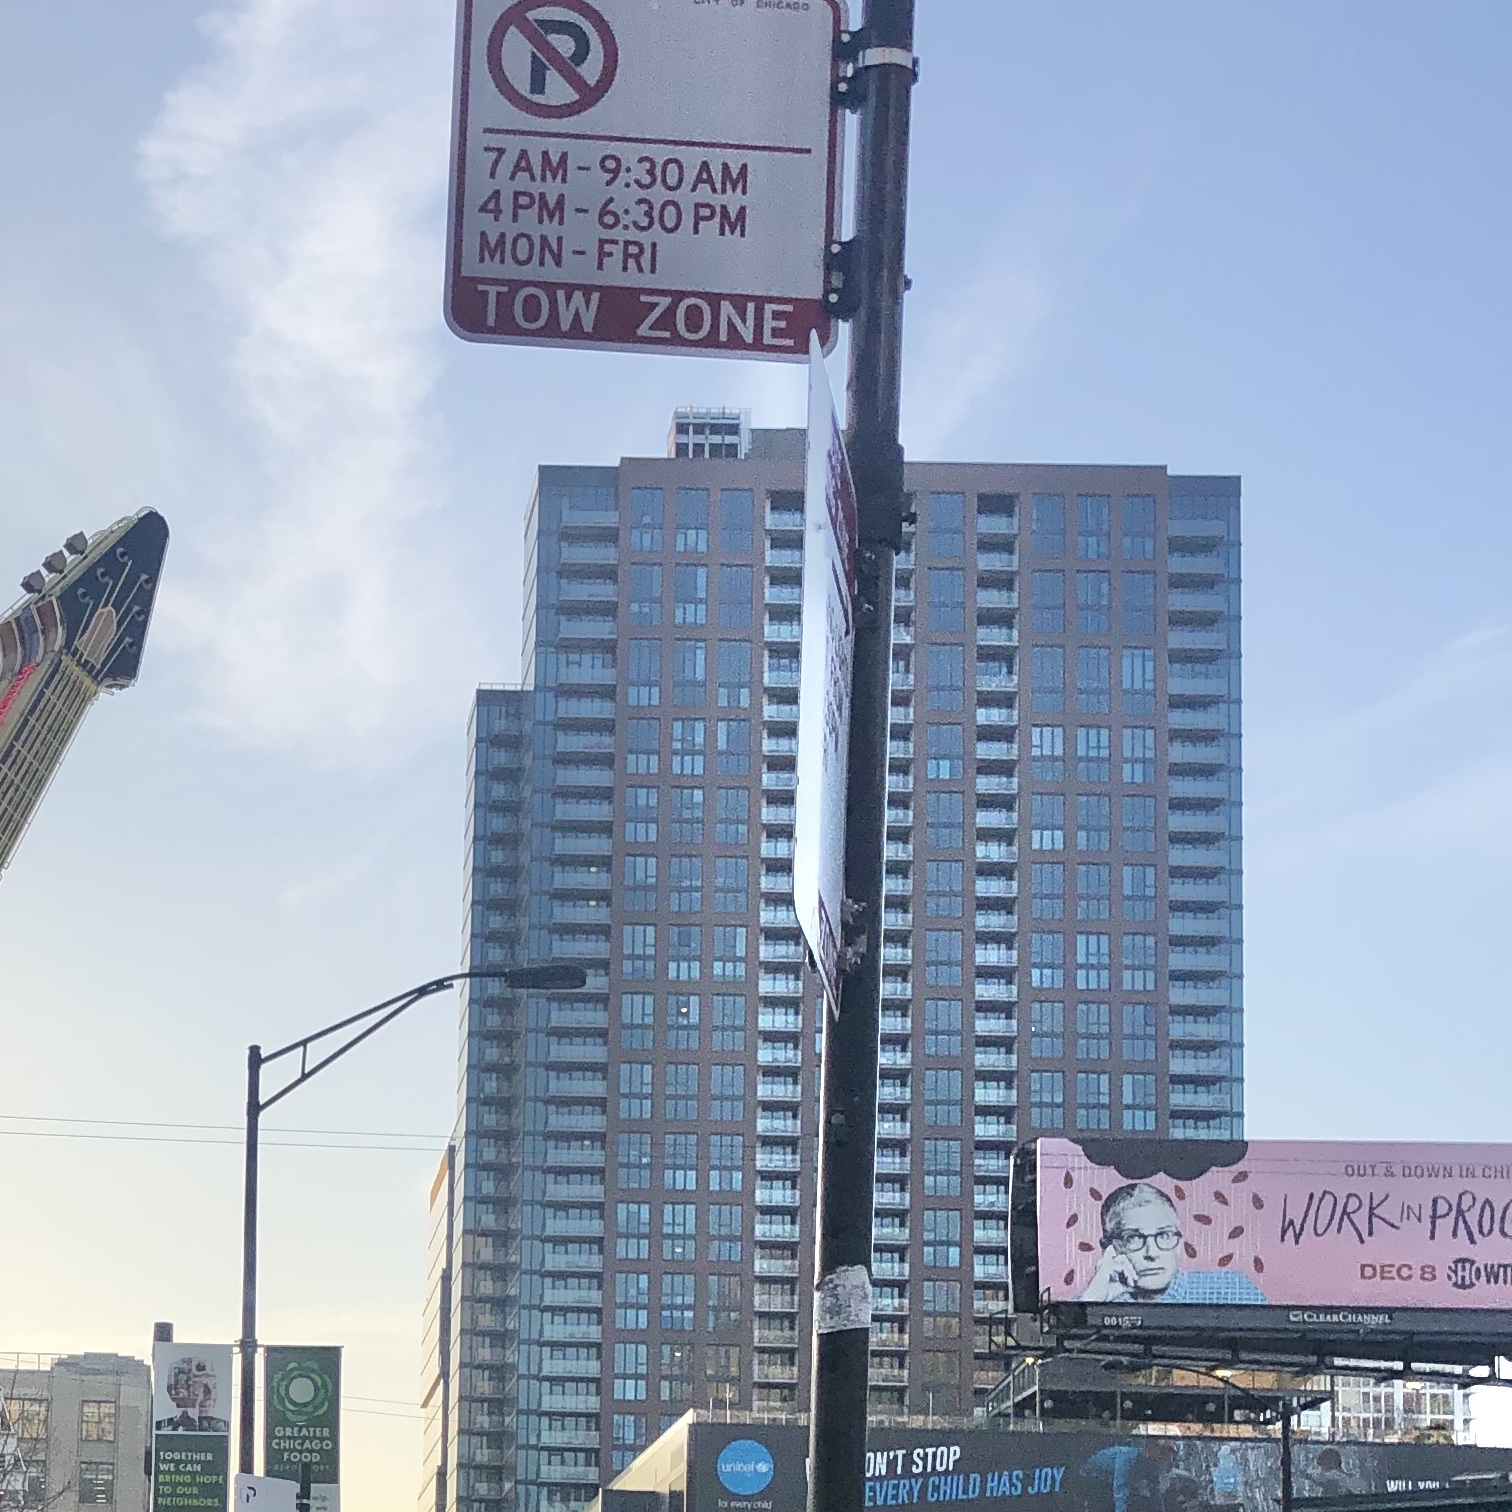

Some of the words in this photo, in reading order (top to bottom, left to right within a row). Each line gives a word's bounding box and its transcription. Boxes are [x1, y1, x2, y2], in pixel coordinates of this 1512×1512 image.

[476, 284, 600, 333] TOW
[635, 295, 796, 347] ZONE
[1344, 1164, 1377, 1177] OUT
[1384, 1164, 1396, 1178] &
[1401, 1164, 1453, 1179] DOWN
[1459, 1165, 1476, 1178] IN
[1280, 1189, 1400, 1246] WORK
[1400, 1201, 1422, 1224] IN
[1360, 1263, 1414, 1281] DEC
[1419, 1263, 1437, 1282] 8
[274, 1426, 331, 1438] GREATER
[271, 1439, 333, 1450] CHICAGO
[159, 1451, 213, 1461] TOGETHER
[283, 1452, 321, 1462] FOOD
[865, 1450, 907, 1478] ON'T
[911, 1445, 961, 1474] STOP
[158, 1463, 176, 1472] WE
[178, 1463, 202, 1472] CAN
[158, 1474, 192, 1483] BRING
[195, 1475, 224, 1484] HOPE
[158, 1485, 172, 1494] TO
[176, 1486, 199, 1495] OUR
[864, 1478, 924, 1507] EVERY
[926, 1473, 981, 1502] CHILD
[985, 1470, 1024, 1498] HAS
[1027, 1466, 1066, 1495] JOY
